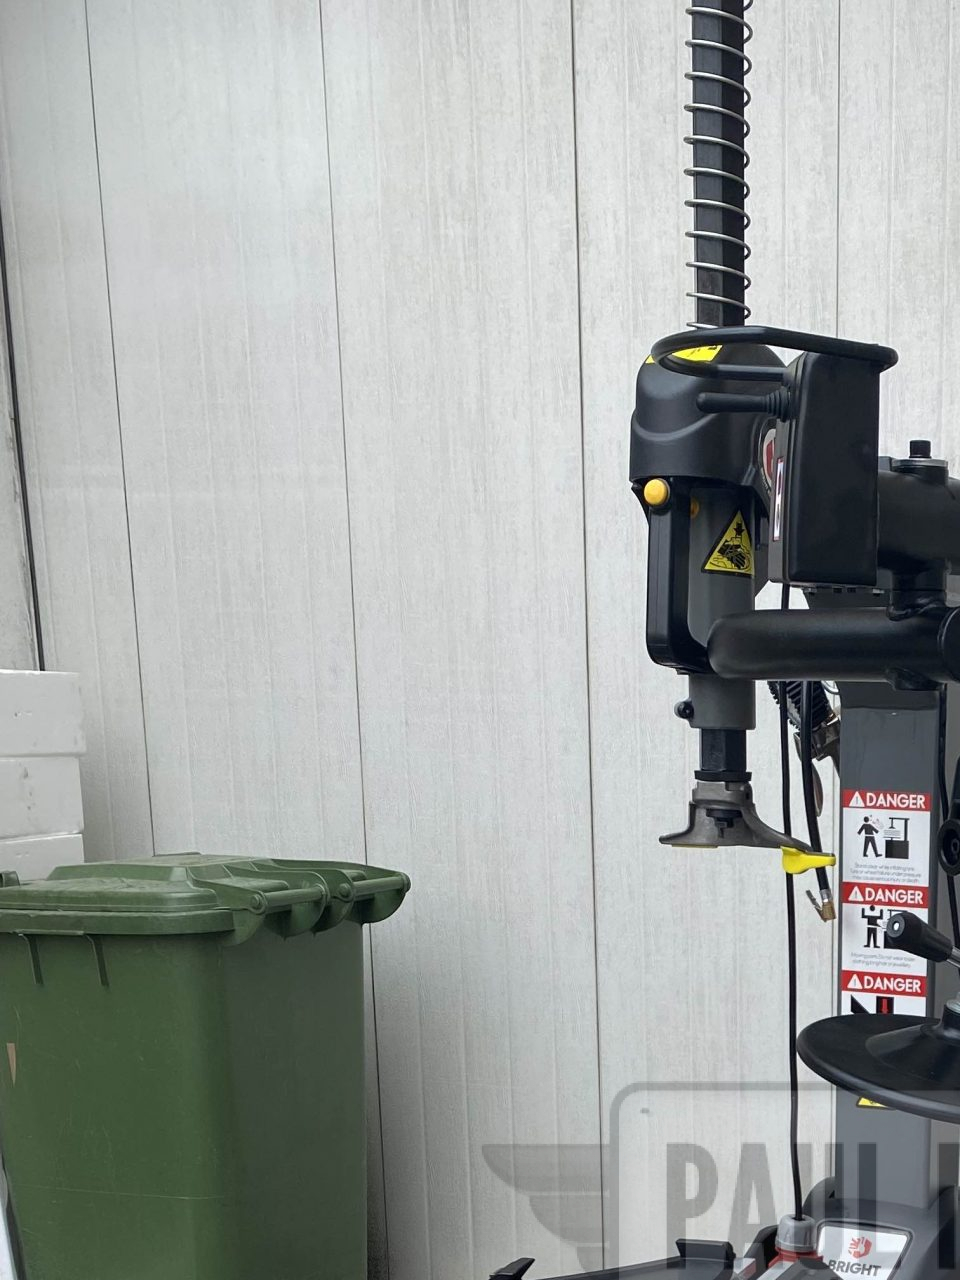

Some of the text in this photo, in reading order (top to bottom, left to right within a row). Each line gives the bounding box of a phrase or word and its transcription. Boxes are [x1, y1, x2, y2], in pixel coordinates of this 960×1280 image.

[866, 792, 926, 809] DANGER
[864, 887, 924, 905] DANGER
[863, 976, 922, 993] DANGER
[828, 1259, 882, 1277] BRIGHT
